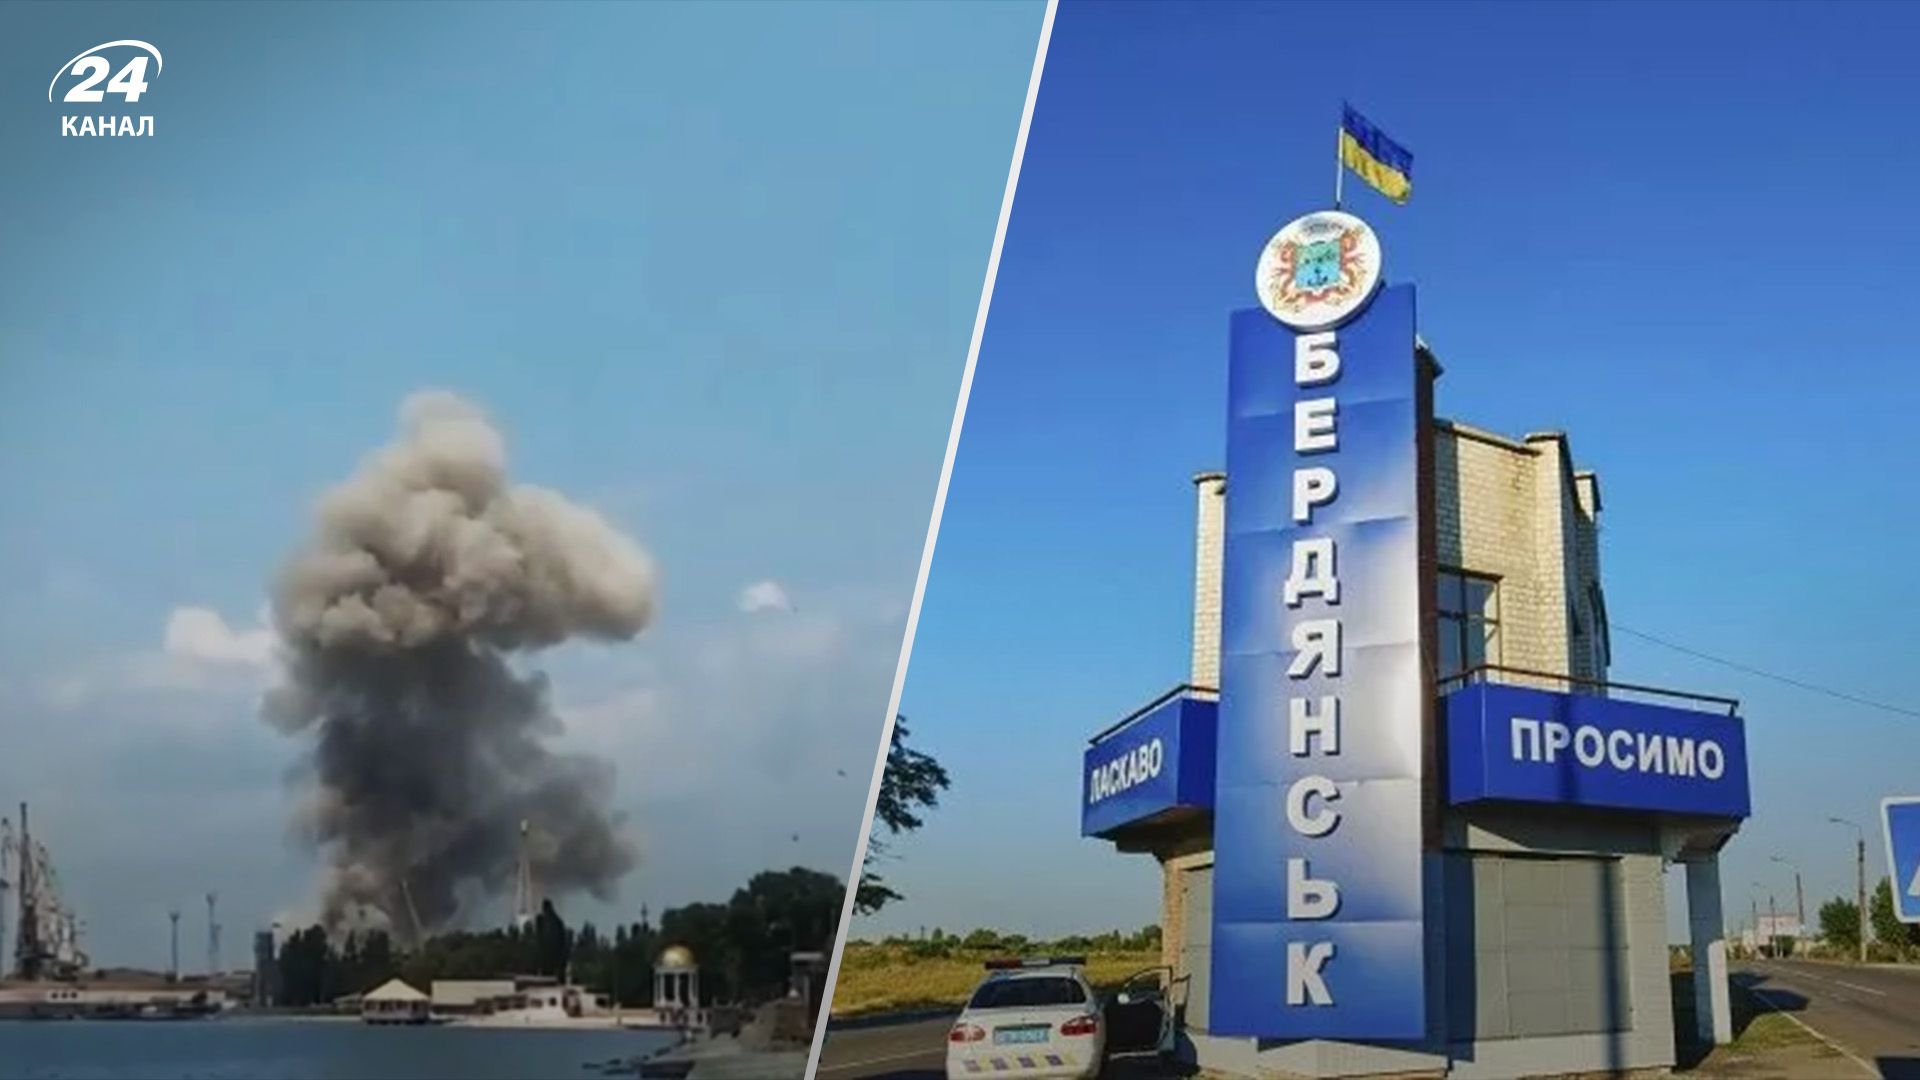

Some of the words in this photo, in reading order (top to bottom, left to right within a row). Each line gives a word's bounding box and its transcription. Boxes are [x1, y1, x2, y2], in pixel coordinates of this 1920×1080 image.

[1284, 331, 1342, 1006] БЕРДЯНСЬК
[1089, 738, 1163, 804] ЛАСКАВО
[1510, 718, 1725, 780] ПРОСИМО
